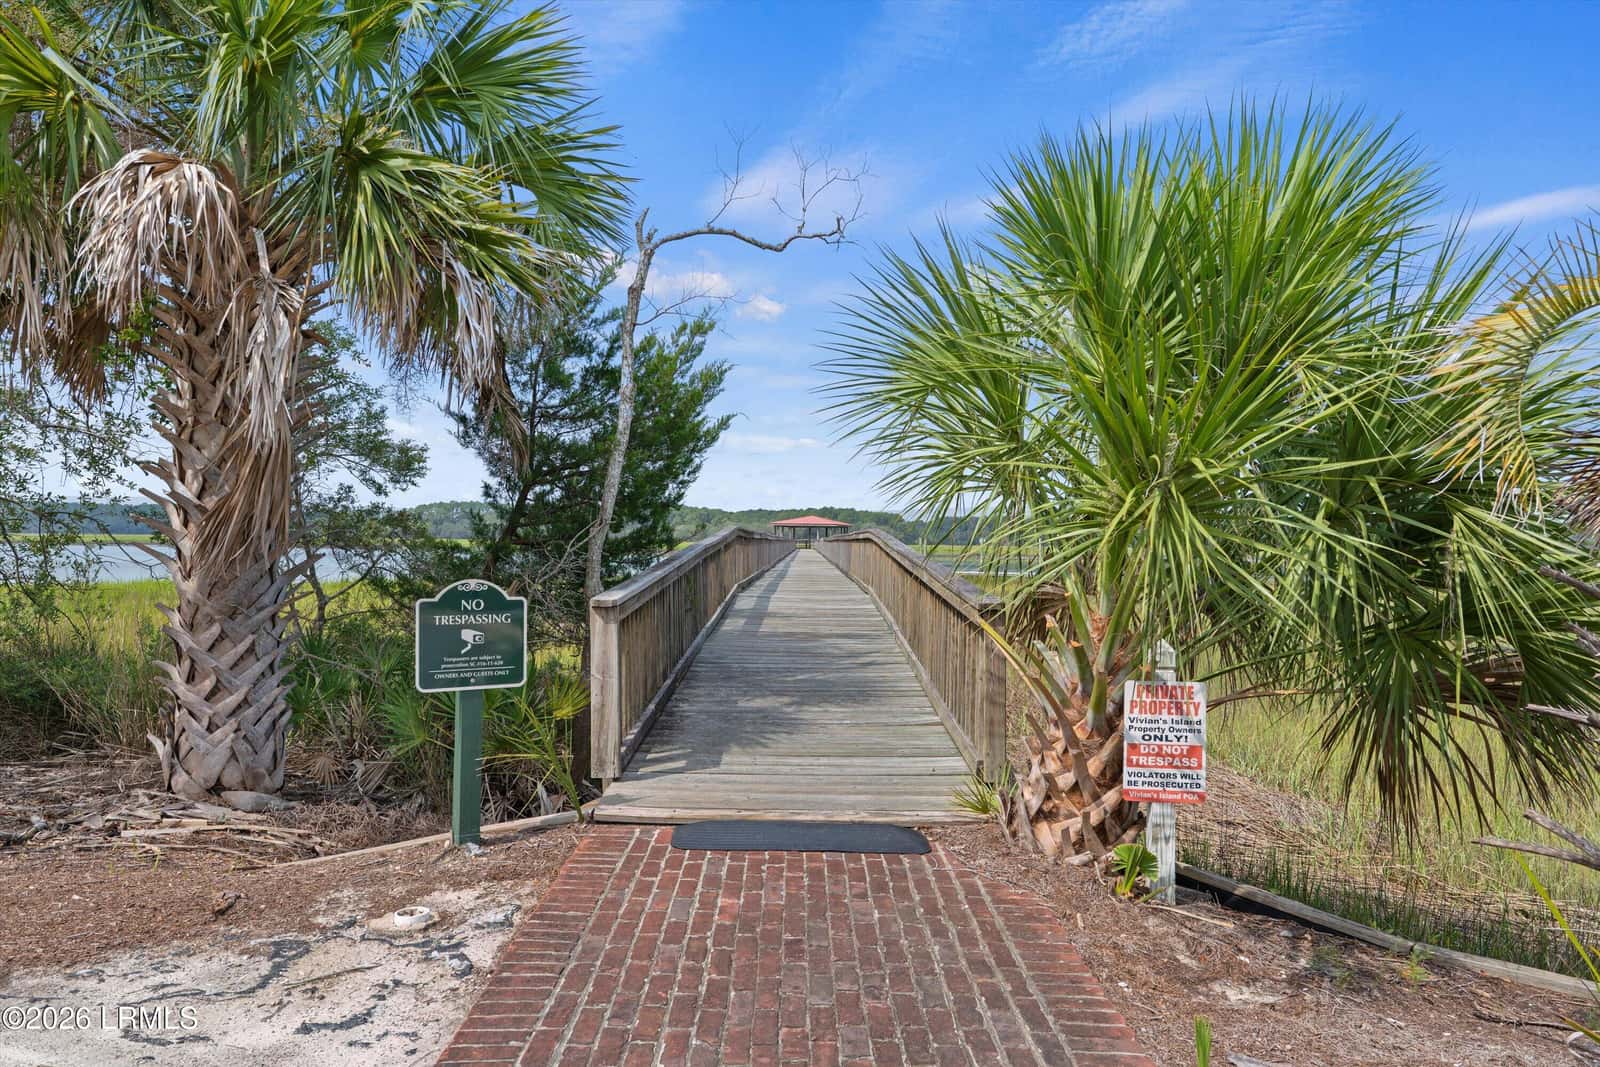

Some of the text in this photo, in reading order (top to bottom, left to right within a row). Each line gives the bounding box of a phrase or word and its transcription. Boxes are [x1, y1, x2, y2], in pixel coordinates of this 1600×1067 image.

[461, 599, 484, 611] NO
[433, 613, 511, 625] TRESPASSING
[1136, 684, 1194, 700] PRIVATE
[1129, 700, 1200, 716] PROPERTY
[1128, 725, 1166, 734] Property
[1142, 734, 1188, 742] ONLY!
[1140, 745, 1189, 754] DO NOT
[1130, 756, 1198, 767] TRESPASS
[1128, 771, 1178, 780] VIOLATORS
[1142, 781, 1201, 789] PROSECUTED
